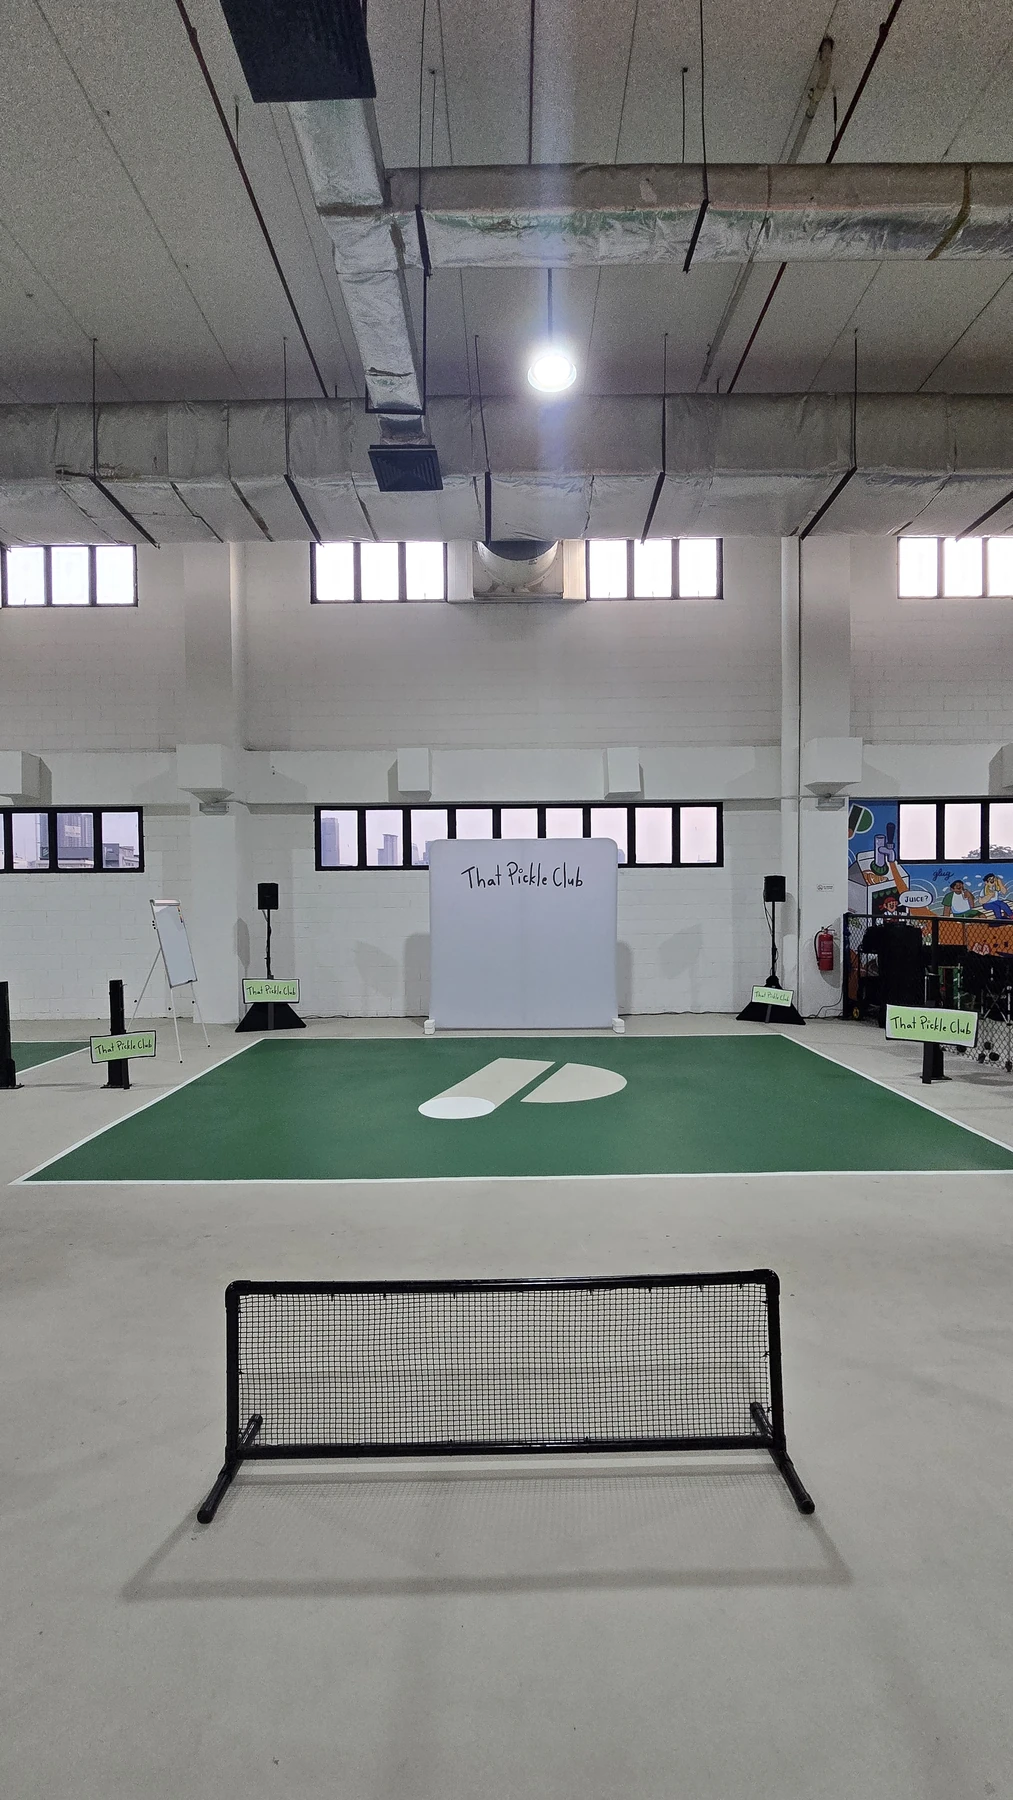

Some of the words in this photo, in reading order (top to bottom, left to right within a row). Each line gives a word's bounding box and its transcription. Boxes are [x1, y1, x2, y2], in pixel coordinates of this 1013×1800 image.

[461, 864, 502, 889] That
[506, 861, 548, 887] Pickle
[552, 861, 584, 888] Club
[932, 868, 955, 881] glug
[246, 985, 263, 996] That
[264, 984, 282, 995] Pickle
[283, 985, 297, 996] Club
[890, 1016, 917, 1029] That
[919, 1015, 947, 1032] Pickle
[949, 1018, 972, 1035] Club
[94, 1042, 115, 1055] That
[115, 1039, 136, 1051] Pickle
[137, 1038, 153, 1050] Club
